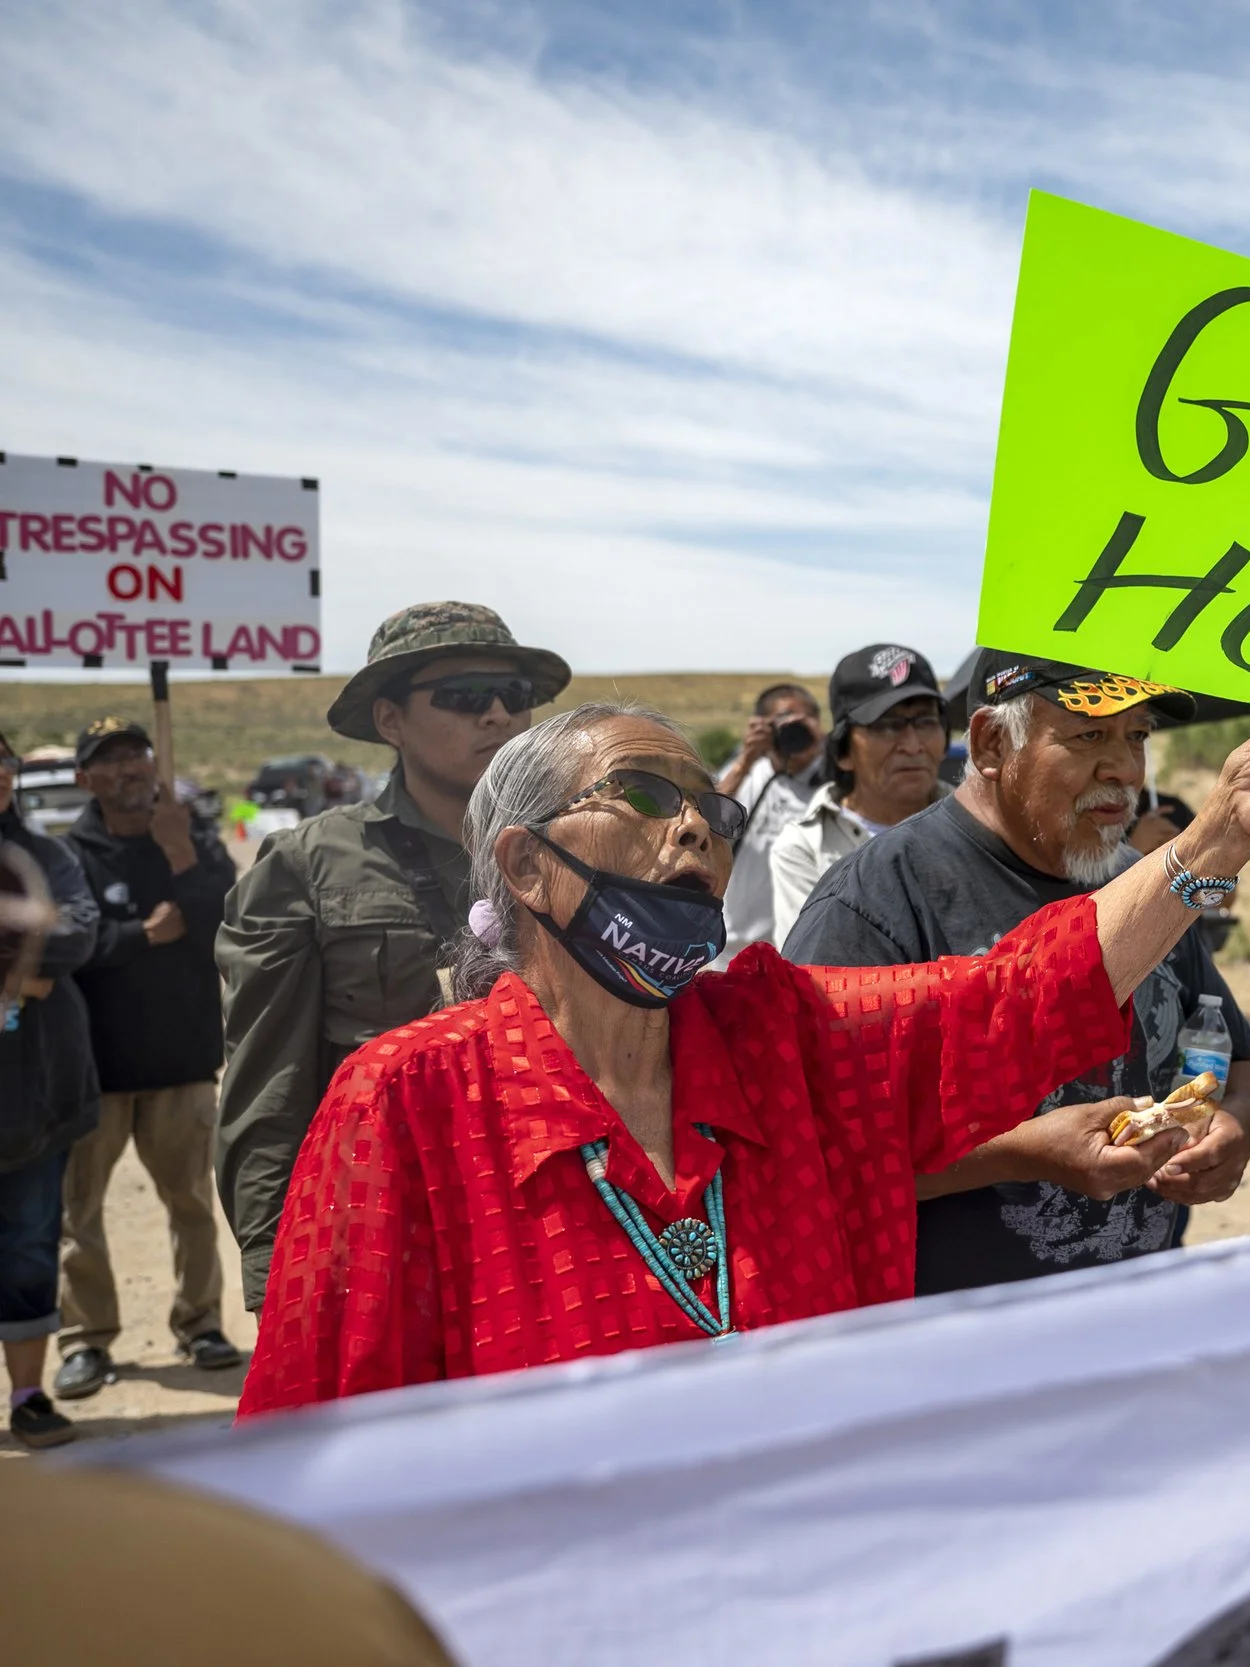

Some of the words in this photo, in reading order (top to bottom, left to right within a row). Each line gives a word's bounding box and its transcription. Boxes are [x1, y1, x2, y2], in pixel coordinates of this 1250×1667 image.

[104, 469, 177, 512] NO
[0, 509, 308, 562] TRESPASSING
[107, 564, 183, 602] ON
[203, 622, 321, 662] LAND
[615, 913, 633, 928] NM
